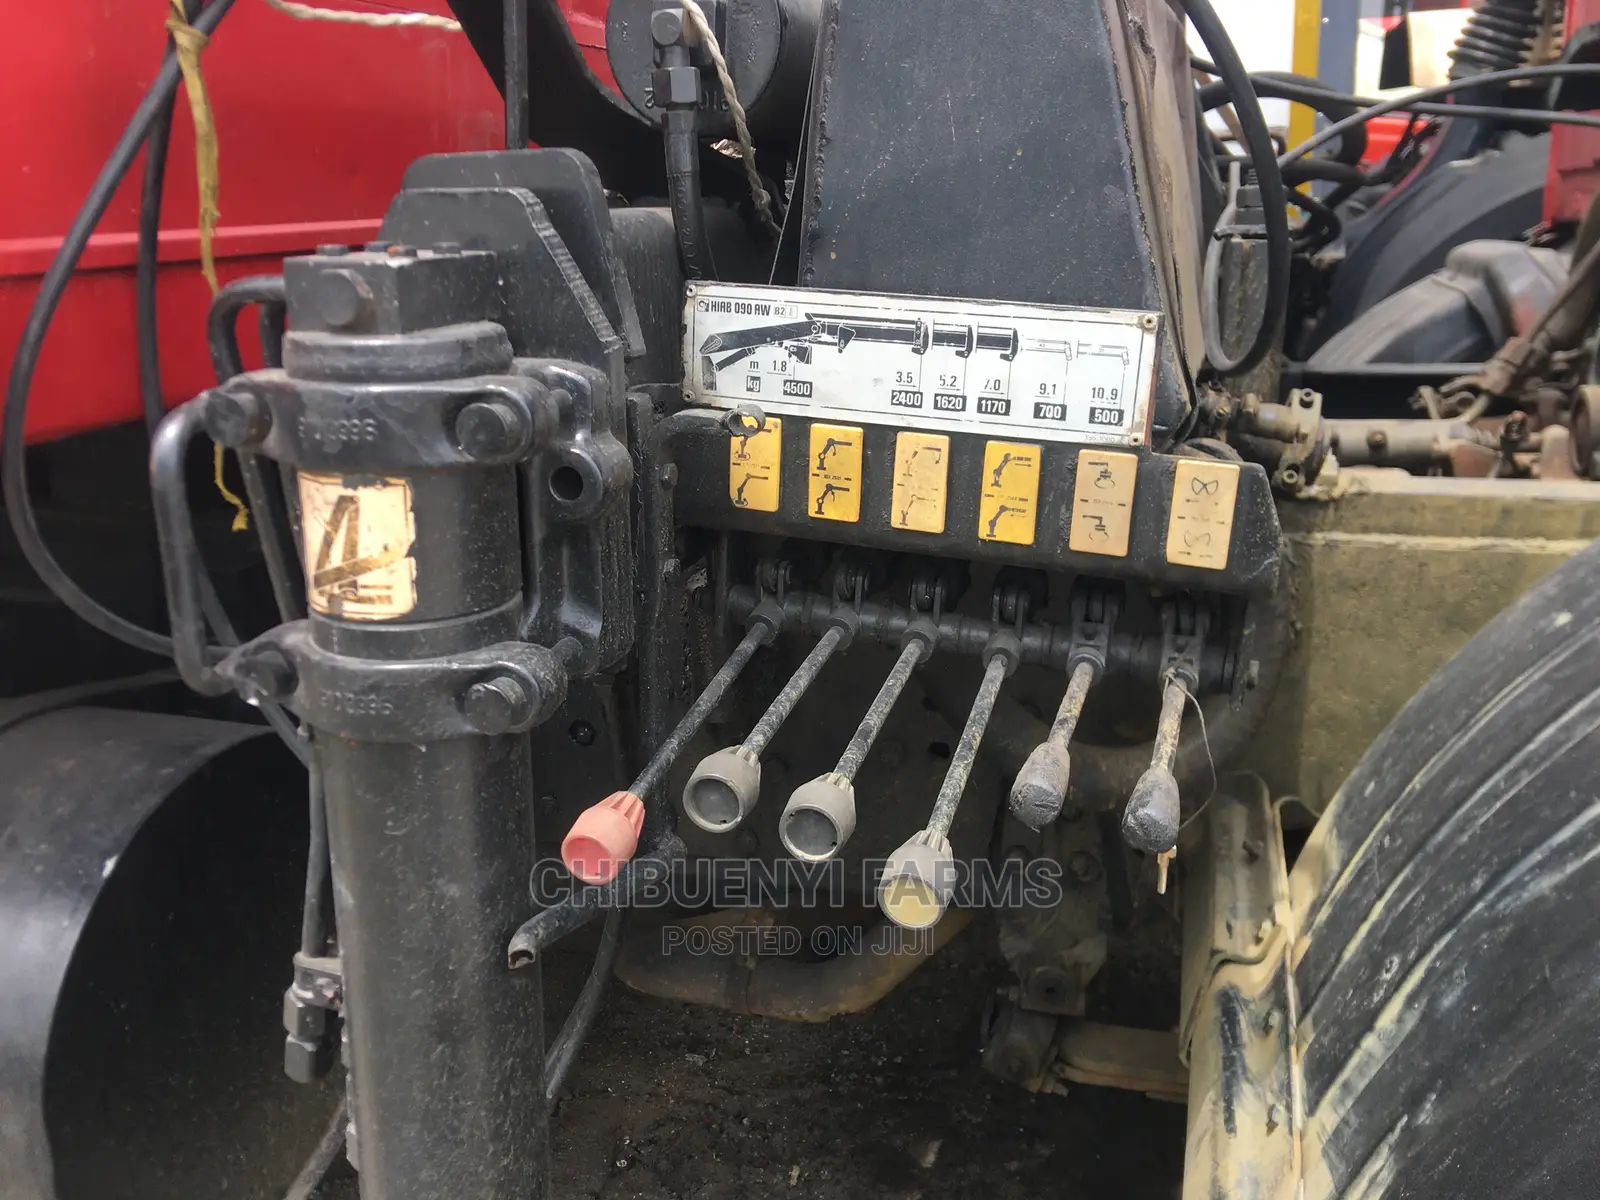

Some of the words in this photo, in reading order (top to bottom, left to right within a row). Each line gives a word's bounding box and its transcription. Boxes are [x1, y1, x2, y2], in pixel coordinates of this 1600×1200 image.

[710, 300, 732, 313] HIAB
[734, 302, 752, 315] 090
[754, 304, 771, 316] AW
[749, 361, 759, 369] m
[772, 360, 787, 372] 1.8
[896, 371, 913, 384] 3.5
[939, 375, 957, 388] 5.2
[1039, 384, 1057, 396] 9.1
[1091, 387, 1118, 400] 10.9
[747, 377, 760, 392] kg
[784, 382, 811, 395] 4500
[892, 391, 921, 406] 2400
[935, 396, 963, 410] 1620
[980, 400, 1006, 414] 1170
[1039, 405, 1062, 420] 700
[1094, 410, 1119, 424] 500
